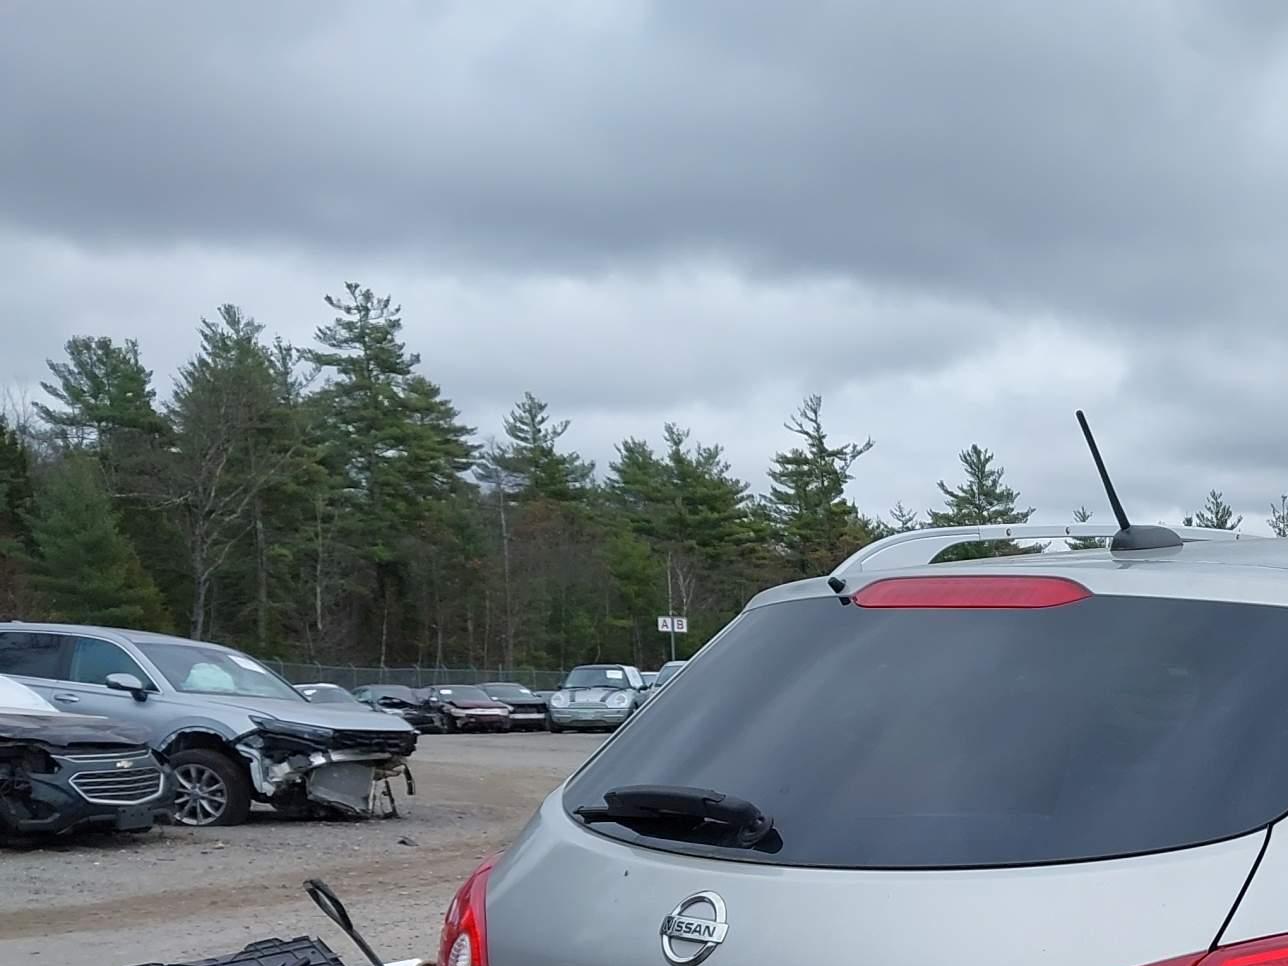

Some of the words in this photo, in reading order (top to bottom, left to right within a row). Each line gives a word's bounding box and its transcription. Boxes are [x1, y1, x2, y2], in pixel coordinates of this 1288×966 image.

[661, 619, 669, 629] A
[676, 619, 684, 629] B
[662, 917, 716, 938] NISSAN
